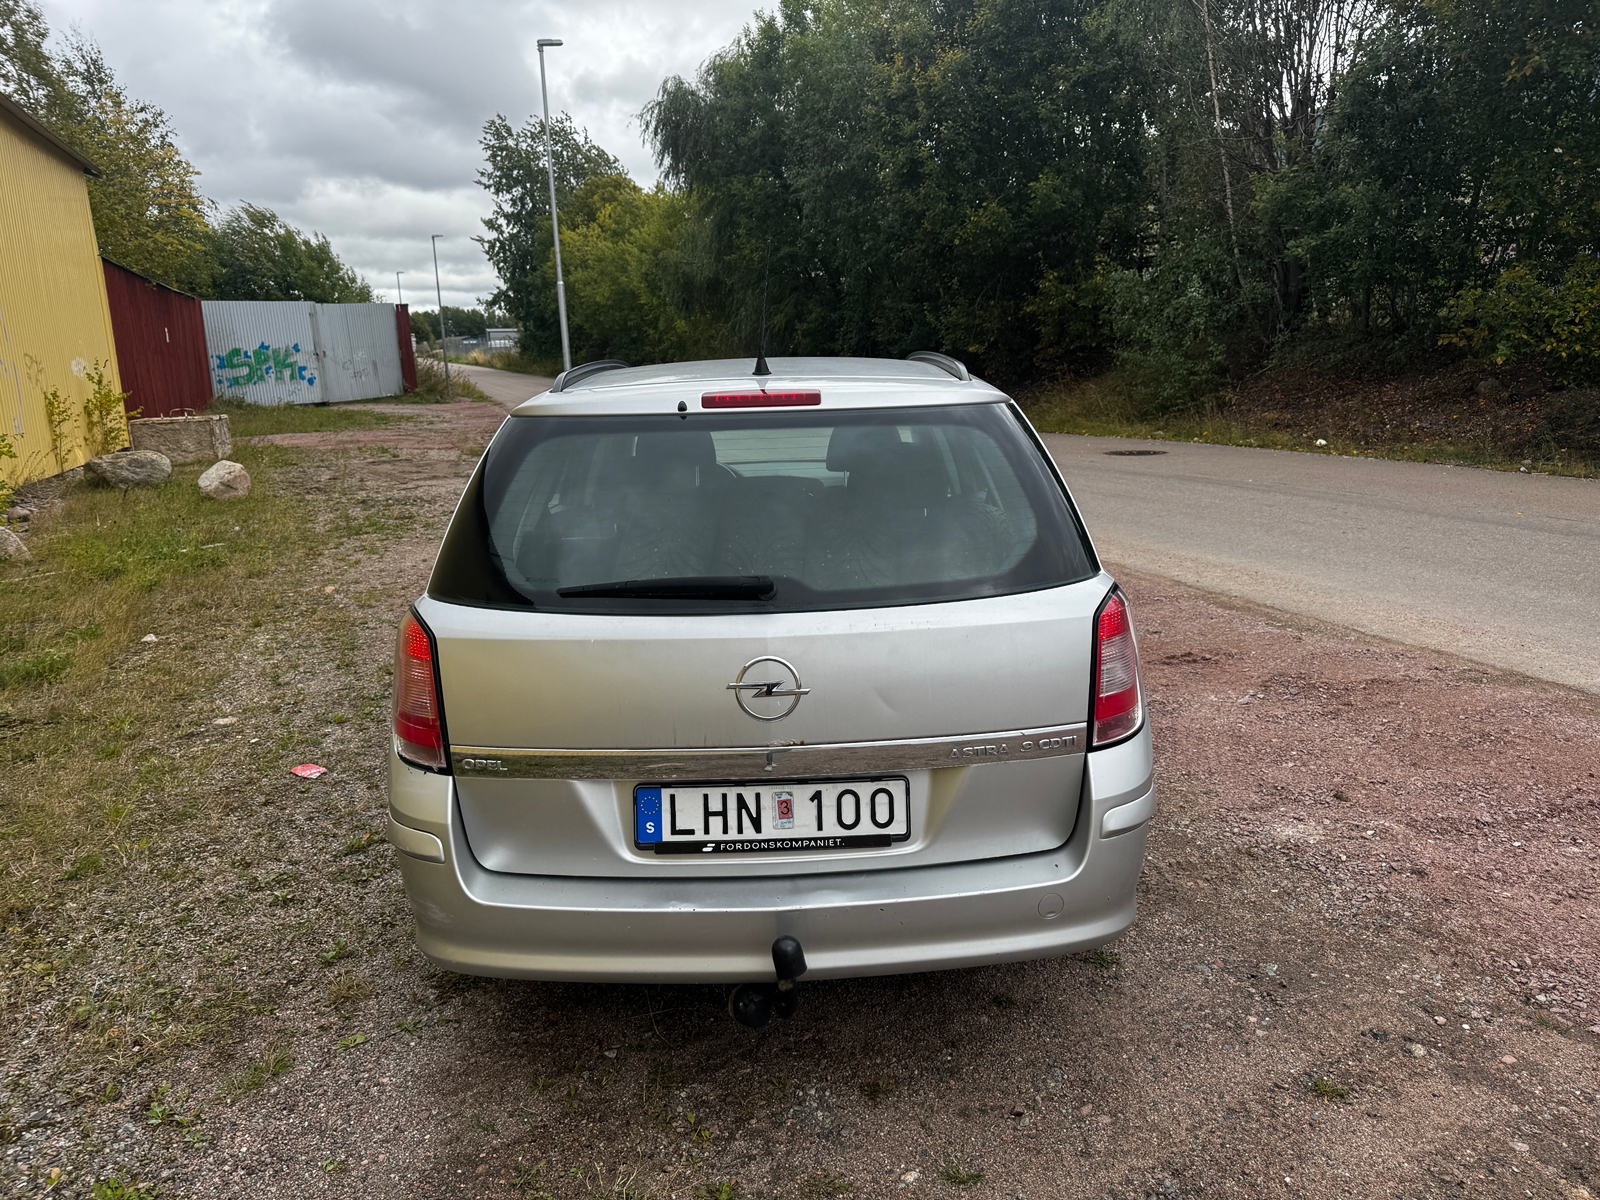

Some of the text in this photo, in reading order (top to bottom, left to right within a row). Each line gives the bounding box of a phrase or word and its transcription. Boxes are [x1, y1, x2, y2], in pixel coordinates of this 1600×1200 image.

[225, 344, 298, 386] SPK
[948, 743, 1011, 760] ASTRA
[1038, 735, 1077, 750] CDTI
[461, 758, 508, 770] OPEL
[669, 787, 895, 835] LHN 100
[780, 800, 790, 815] 3
[645, 821, 655, 834] S
[720, 838, 846, 851] FORDONSKOMPANIET.
